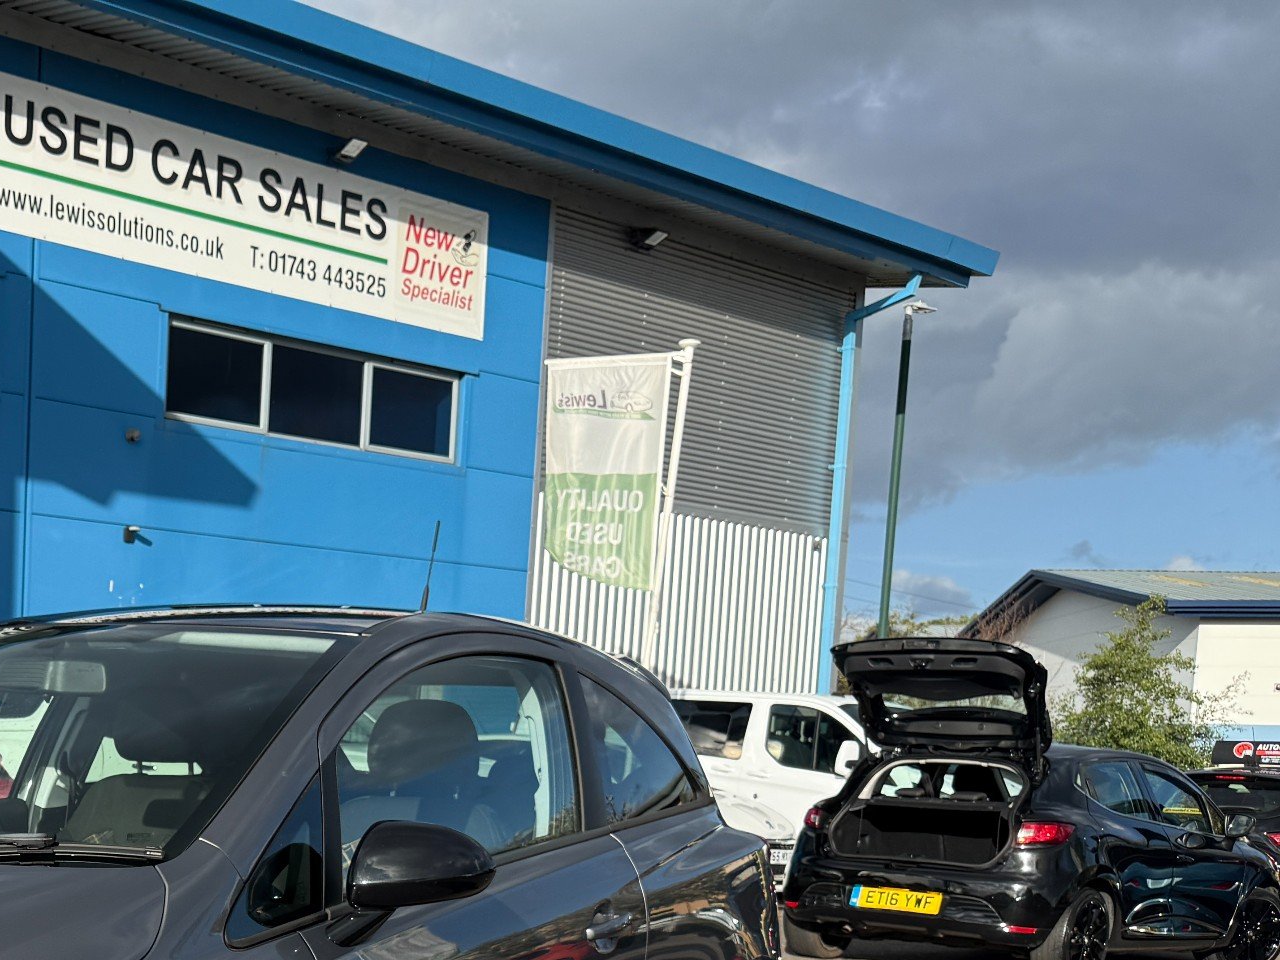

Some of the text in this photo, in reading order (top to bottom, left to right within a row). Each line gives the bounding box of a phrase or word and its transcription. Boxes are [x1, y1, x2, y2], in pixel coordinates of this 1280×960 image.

[4, 95, 388, 241] USED CAR SALES
[405, 214, 455, 252] New
[323, 264, 387, 299] 443525
[402, 247, 474, 291] Driver
[400, 278, 473, 312] Specialist
[865, 890, 935, 909] ET16 YWF
